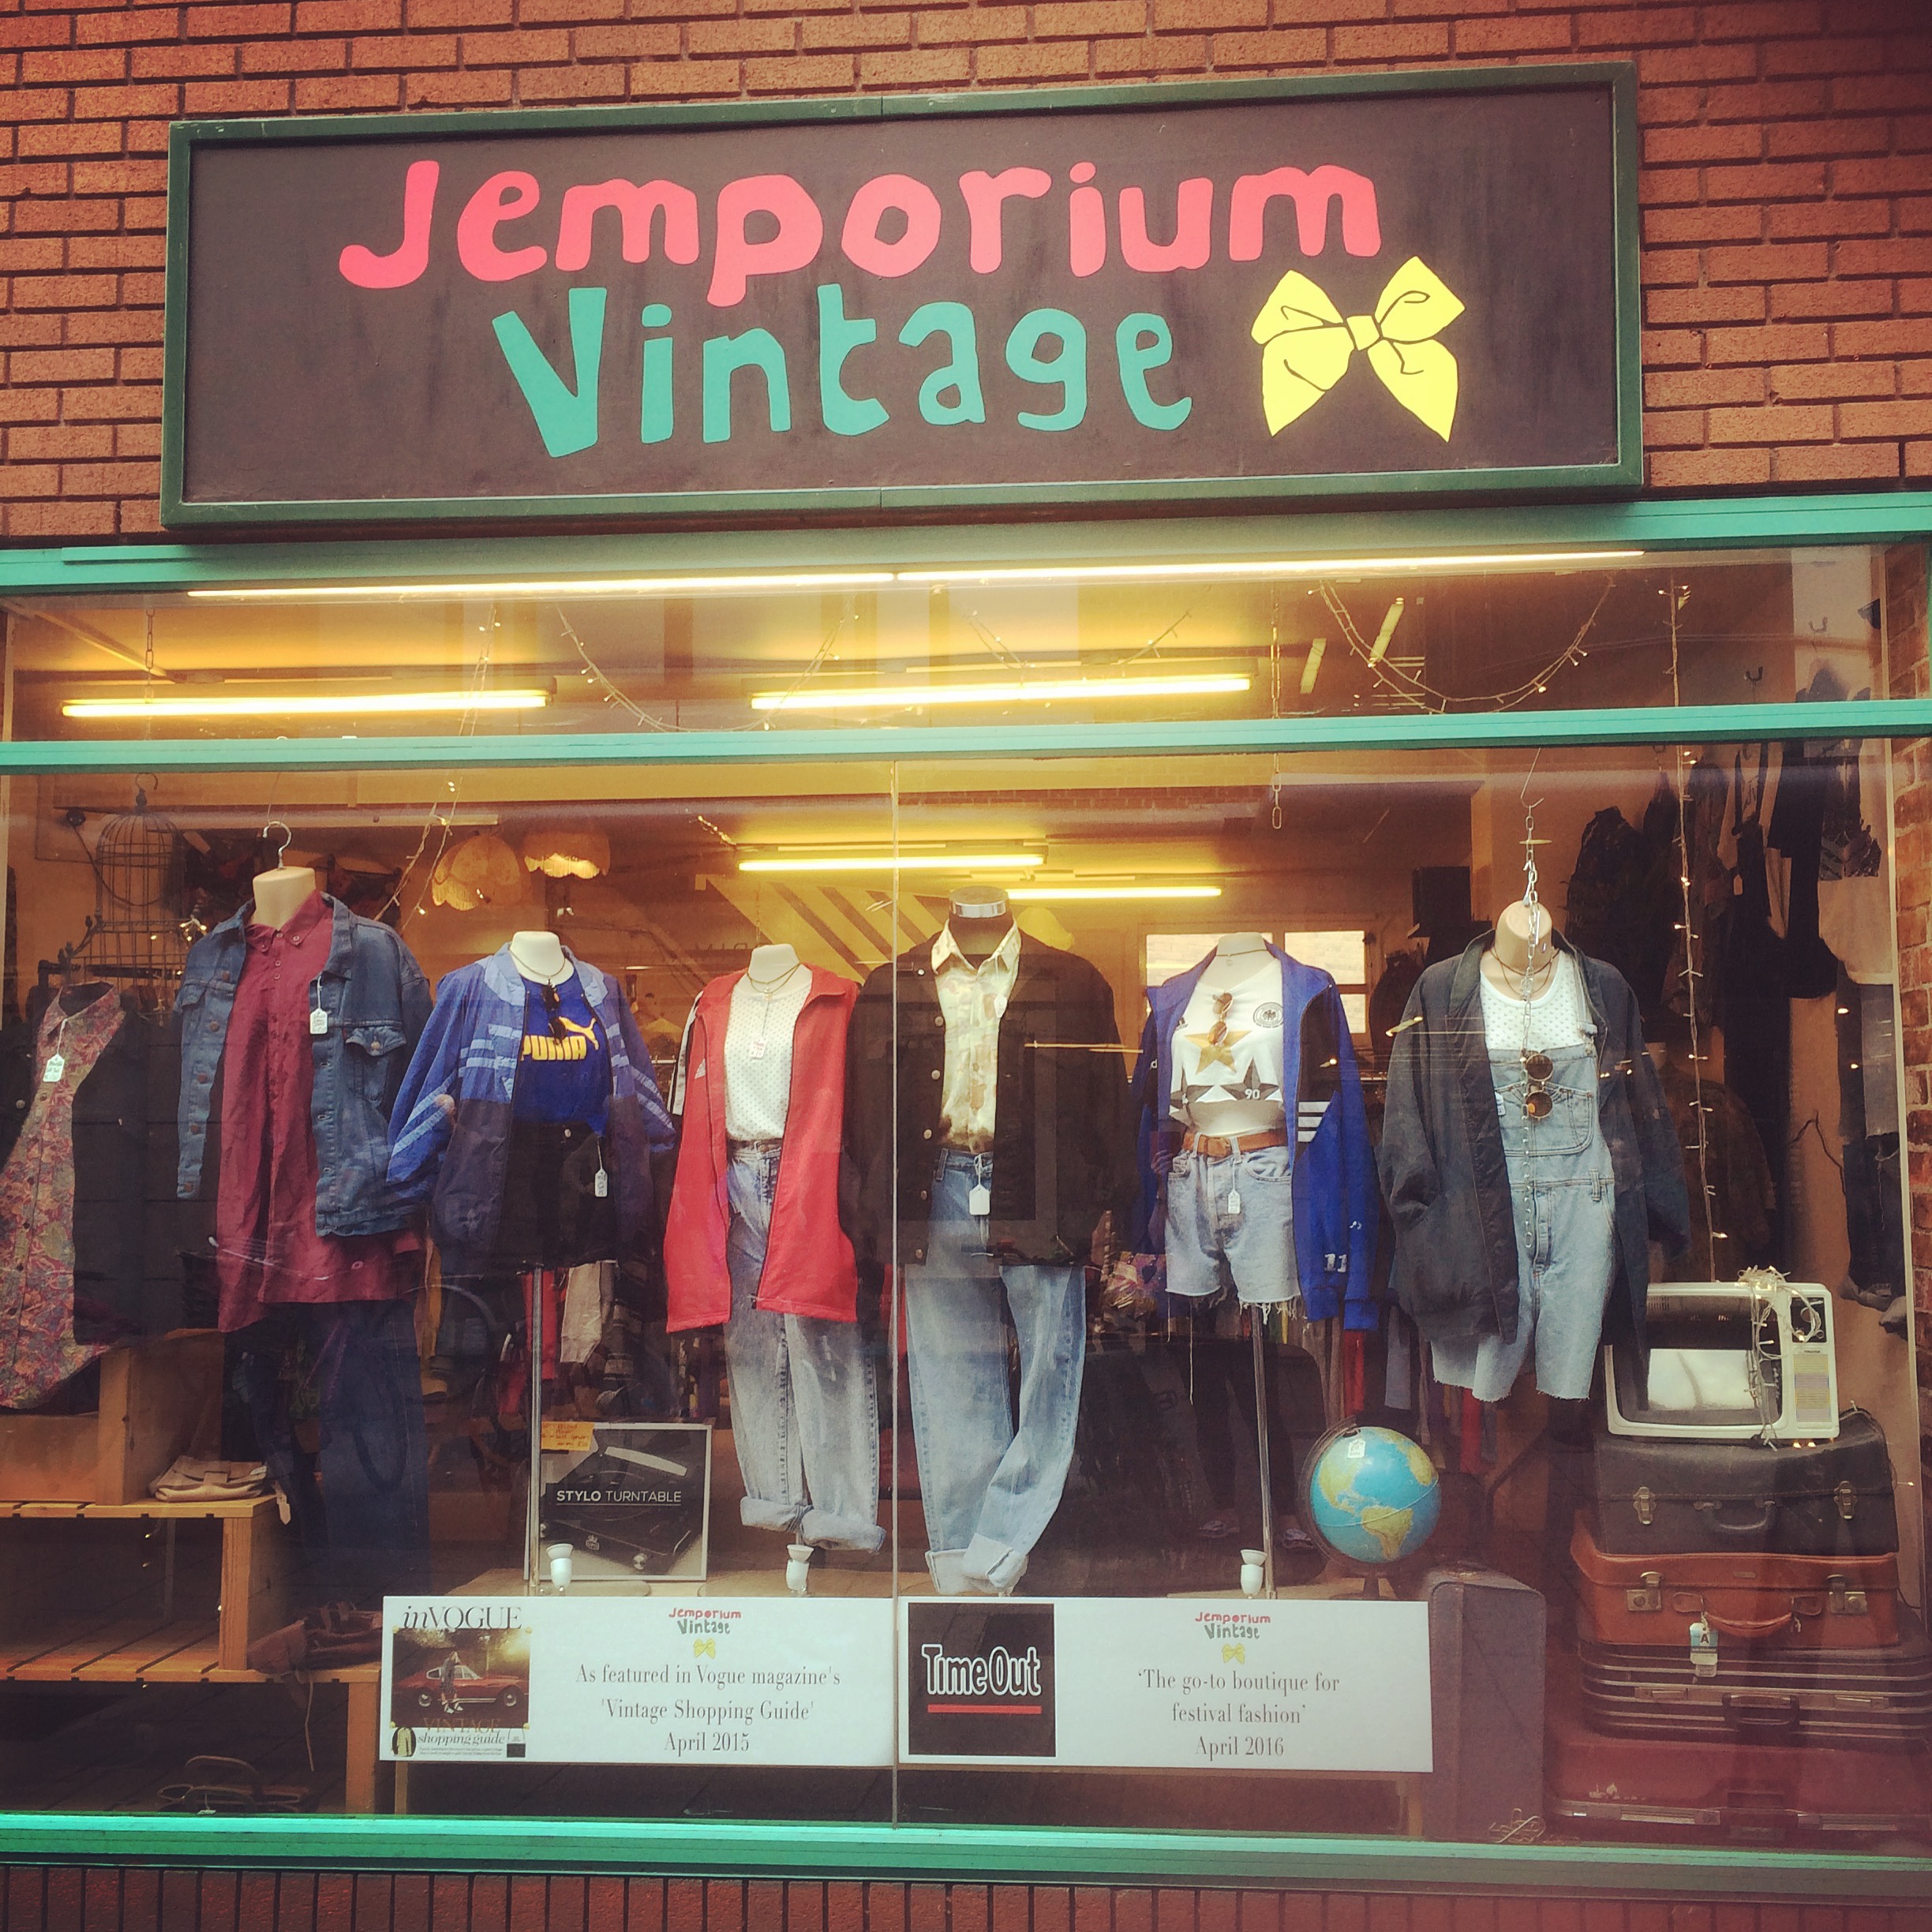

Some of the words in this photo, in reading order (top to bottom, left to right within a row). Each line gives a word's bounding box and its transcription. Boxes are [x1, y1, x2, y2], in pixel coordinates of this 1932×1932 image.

[339, 161, 1381, 308] Jemporium
[492, 285, 1192, 458] Vintage
[521, 1035, 587, 1061] PUMA
[1245, 1088, 1260, 1100] 90
[556, 1490, 601, 1502] STYLO
[605, 1490, 682, 1503] TURNTABLE
[677, 1619, 731, 1634] Vintage
[1204, 1623, 1260, 1639] Vintage
[576, 1664, 597, 1683] As
[602, 1664, 669, 1684] featured
[676, 1664, 691, 1684] in
[695, 1664, 746, 1690] Vogue
[751, 1666, 841, 1690] magazine's
[1181, 1670, 1226, 1696] go-to
[1232, 1670, 1309, 1698] boutique
[1315, 1672, 1340, 1691] for
[673, 1699, 754, 1725] Shopping
[1172, 1702, 1232, 1723] festival
[417, 1732, 471, 1747] shopping
[472, 1732, 506, 1746] guide
[665, 1732, 708, 1757] April
[711, 1732, 750, 1752] 2015
[1196, 1736, 1238, 1762] April
[1245, 1736, 1284, 1757] 2016
